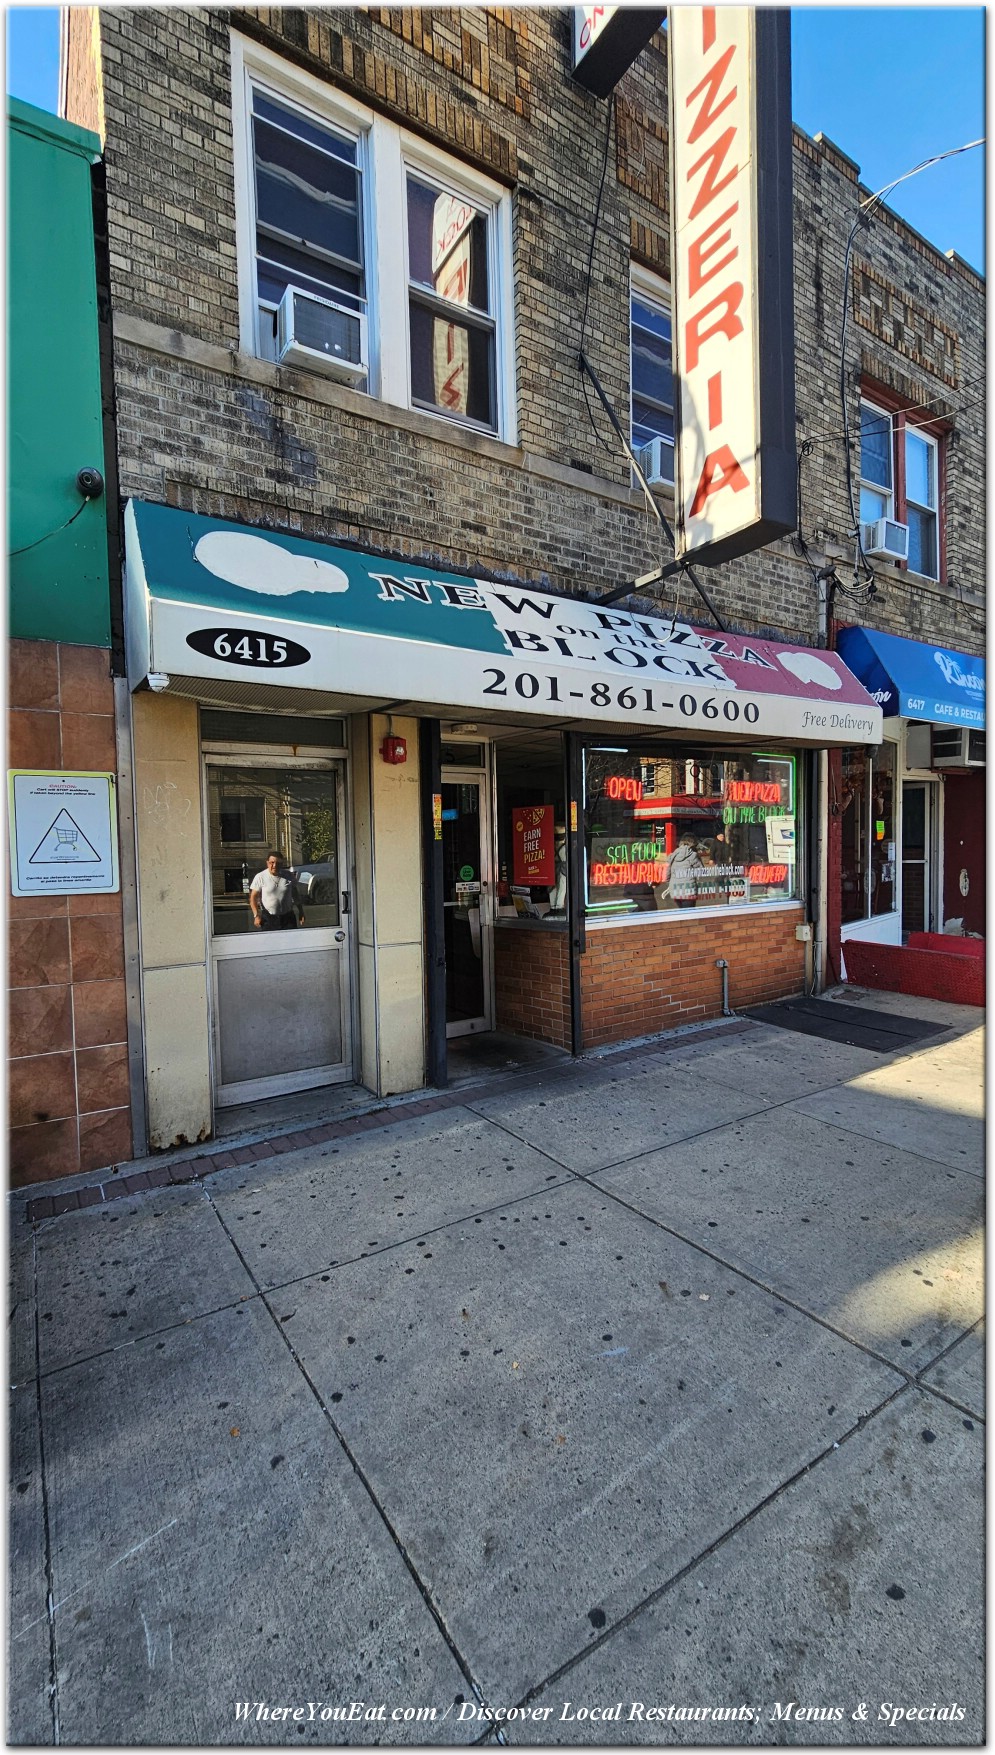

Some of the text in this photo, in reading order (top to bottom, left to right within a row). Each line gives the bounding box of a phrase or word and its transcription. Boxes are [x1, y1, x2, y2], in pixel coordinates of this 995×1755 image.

[369, 572, 778, 671] NEW PIZZA
[213, 632, 288, 663] 6415
[556, 624, 669, 652] on the
[504, 628, 727, 682] BLOCK
[482, 668, 760, 724] 201-861-0600
[908, 698, 925, 711] 6417
[934, 703, 954, 716] CAFE
[954, 708, 960, 717] &
[802, 711, 874, 735] Free Delivery
[608, 776, 643, 802] OPEN
[754, 783, 781, 803] PIZZA
[523, 827, 542, 842] EARN
[523, 841, 540, 853] FREE
[523, 850, 546, 864] PIZZA!
[607, 844, 630, 865] SEA
[594, 863, 669, 885] RESTAURANT
[750, 865, 788, 883] DELIVERY
[673, 878, 746, 902] ITALIAN FOOD
